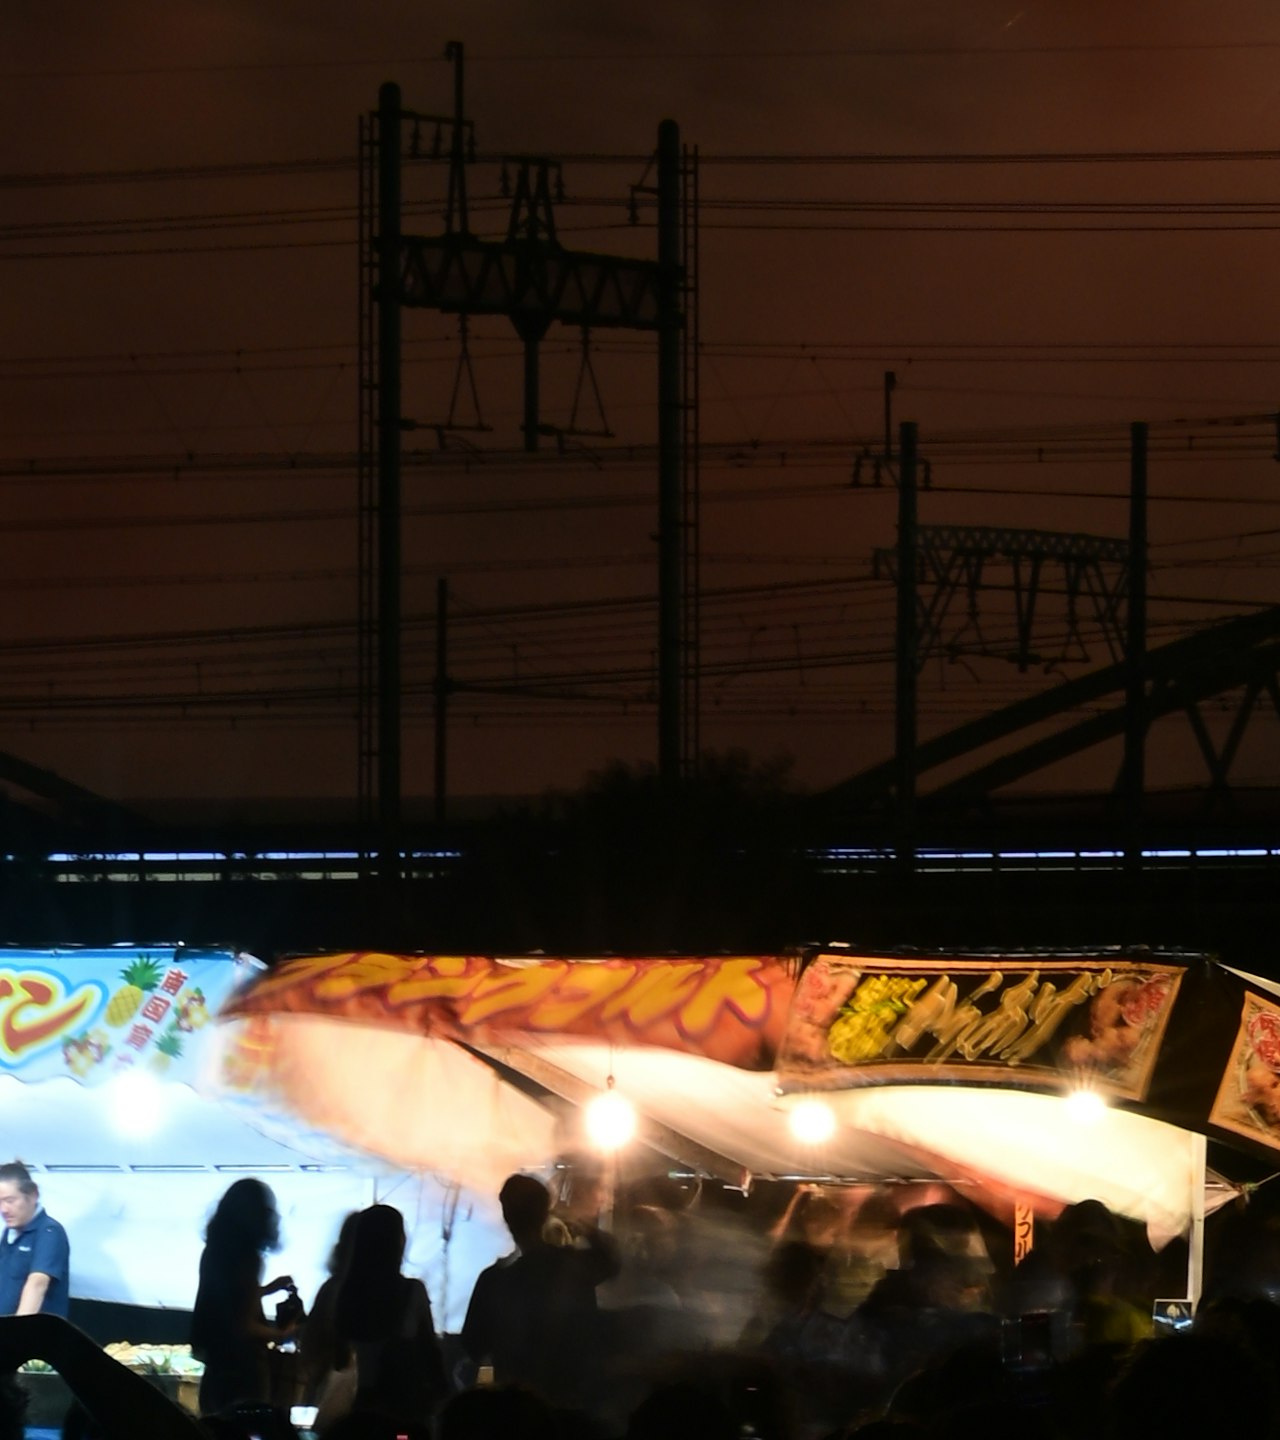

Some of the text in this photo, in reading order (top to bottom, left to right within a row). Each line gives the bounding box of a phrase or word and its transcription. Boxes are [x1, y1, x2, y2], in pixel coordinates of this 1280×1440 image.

[0, 978, 88, 1054] ン
[252, 954, 770, 1032] フランクフルト
